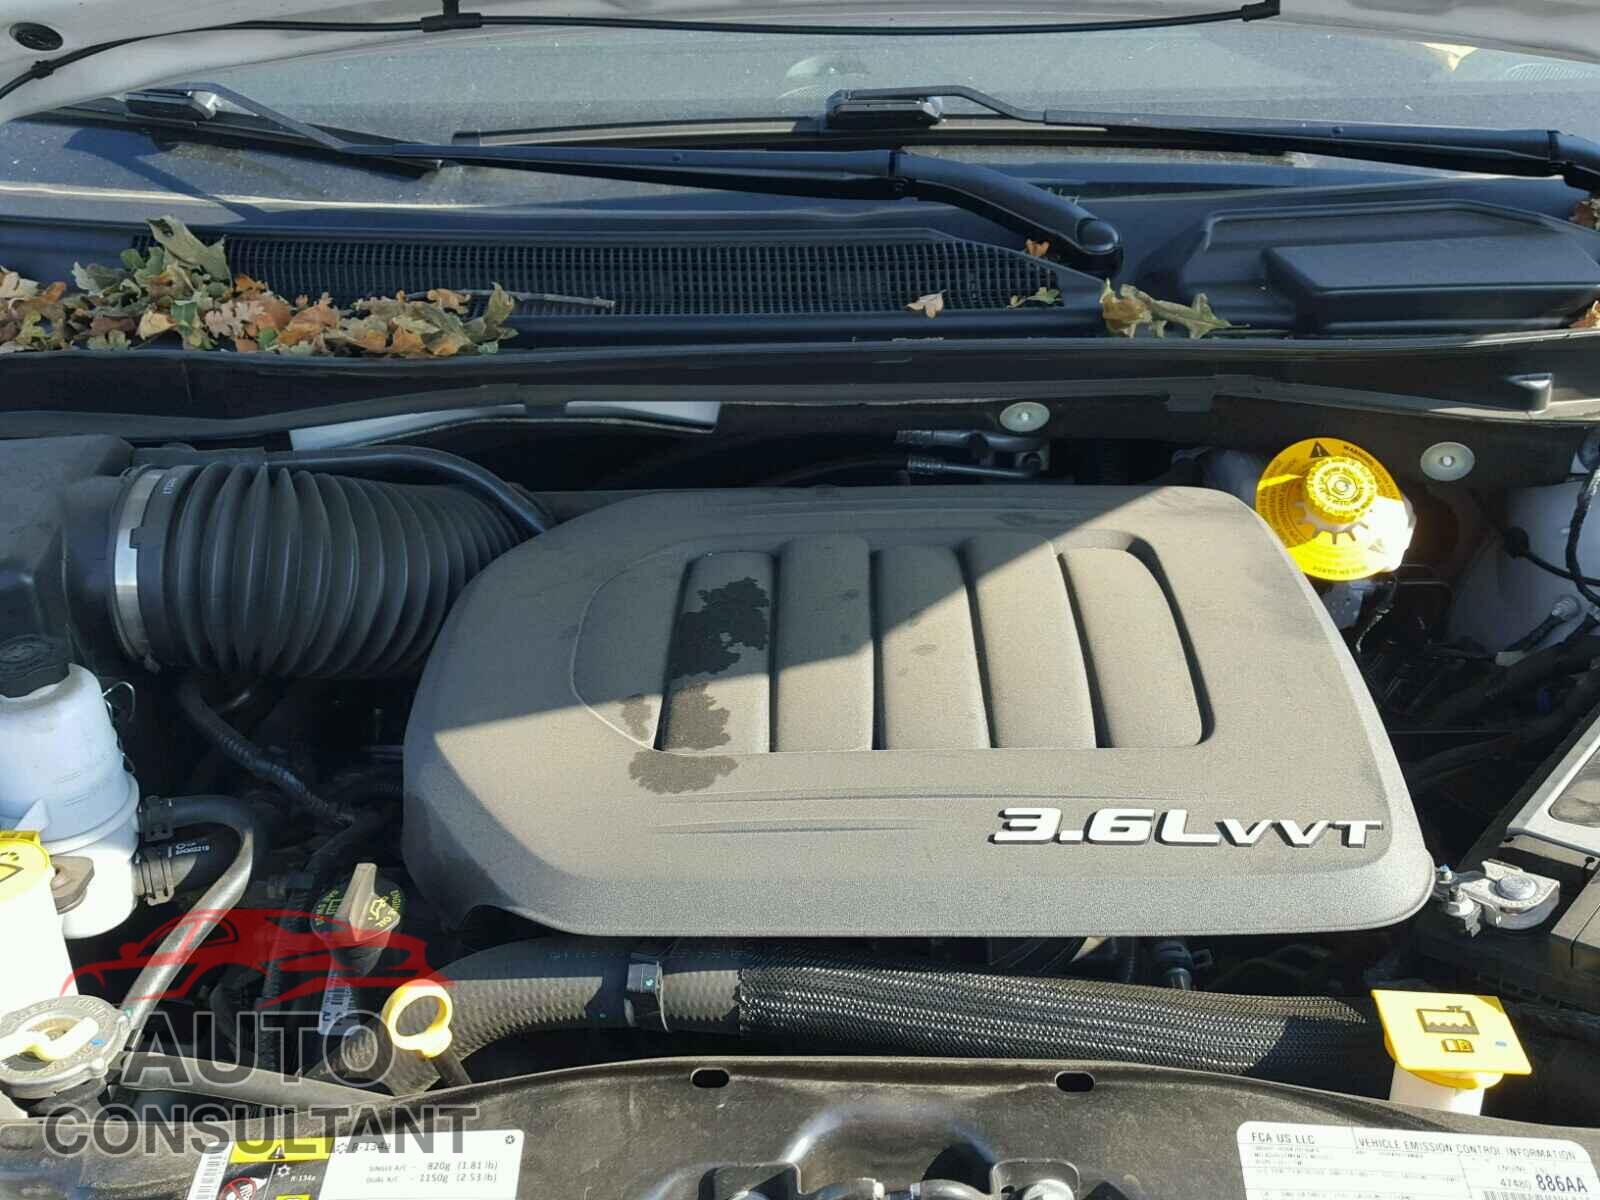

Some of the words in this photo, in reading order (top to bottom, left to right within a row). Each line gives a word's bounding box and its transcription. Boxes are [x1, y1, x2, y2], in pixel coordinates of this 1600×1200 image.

[1403, 1139, 1453, 1153] EMISSION
[1506, 1146, 1576, 1161] INFORMATION
[1535, 1173, 1588, 1193] 886AA
